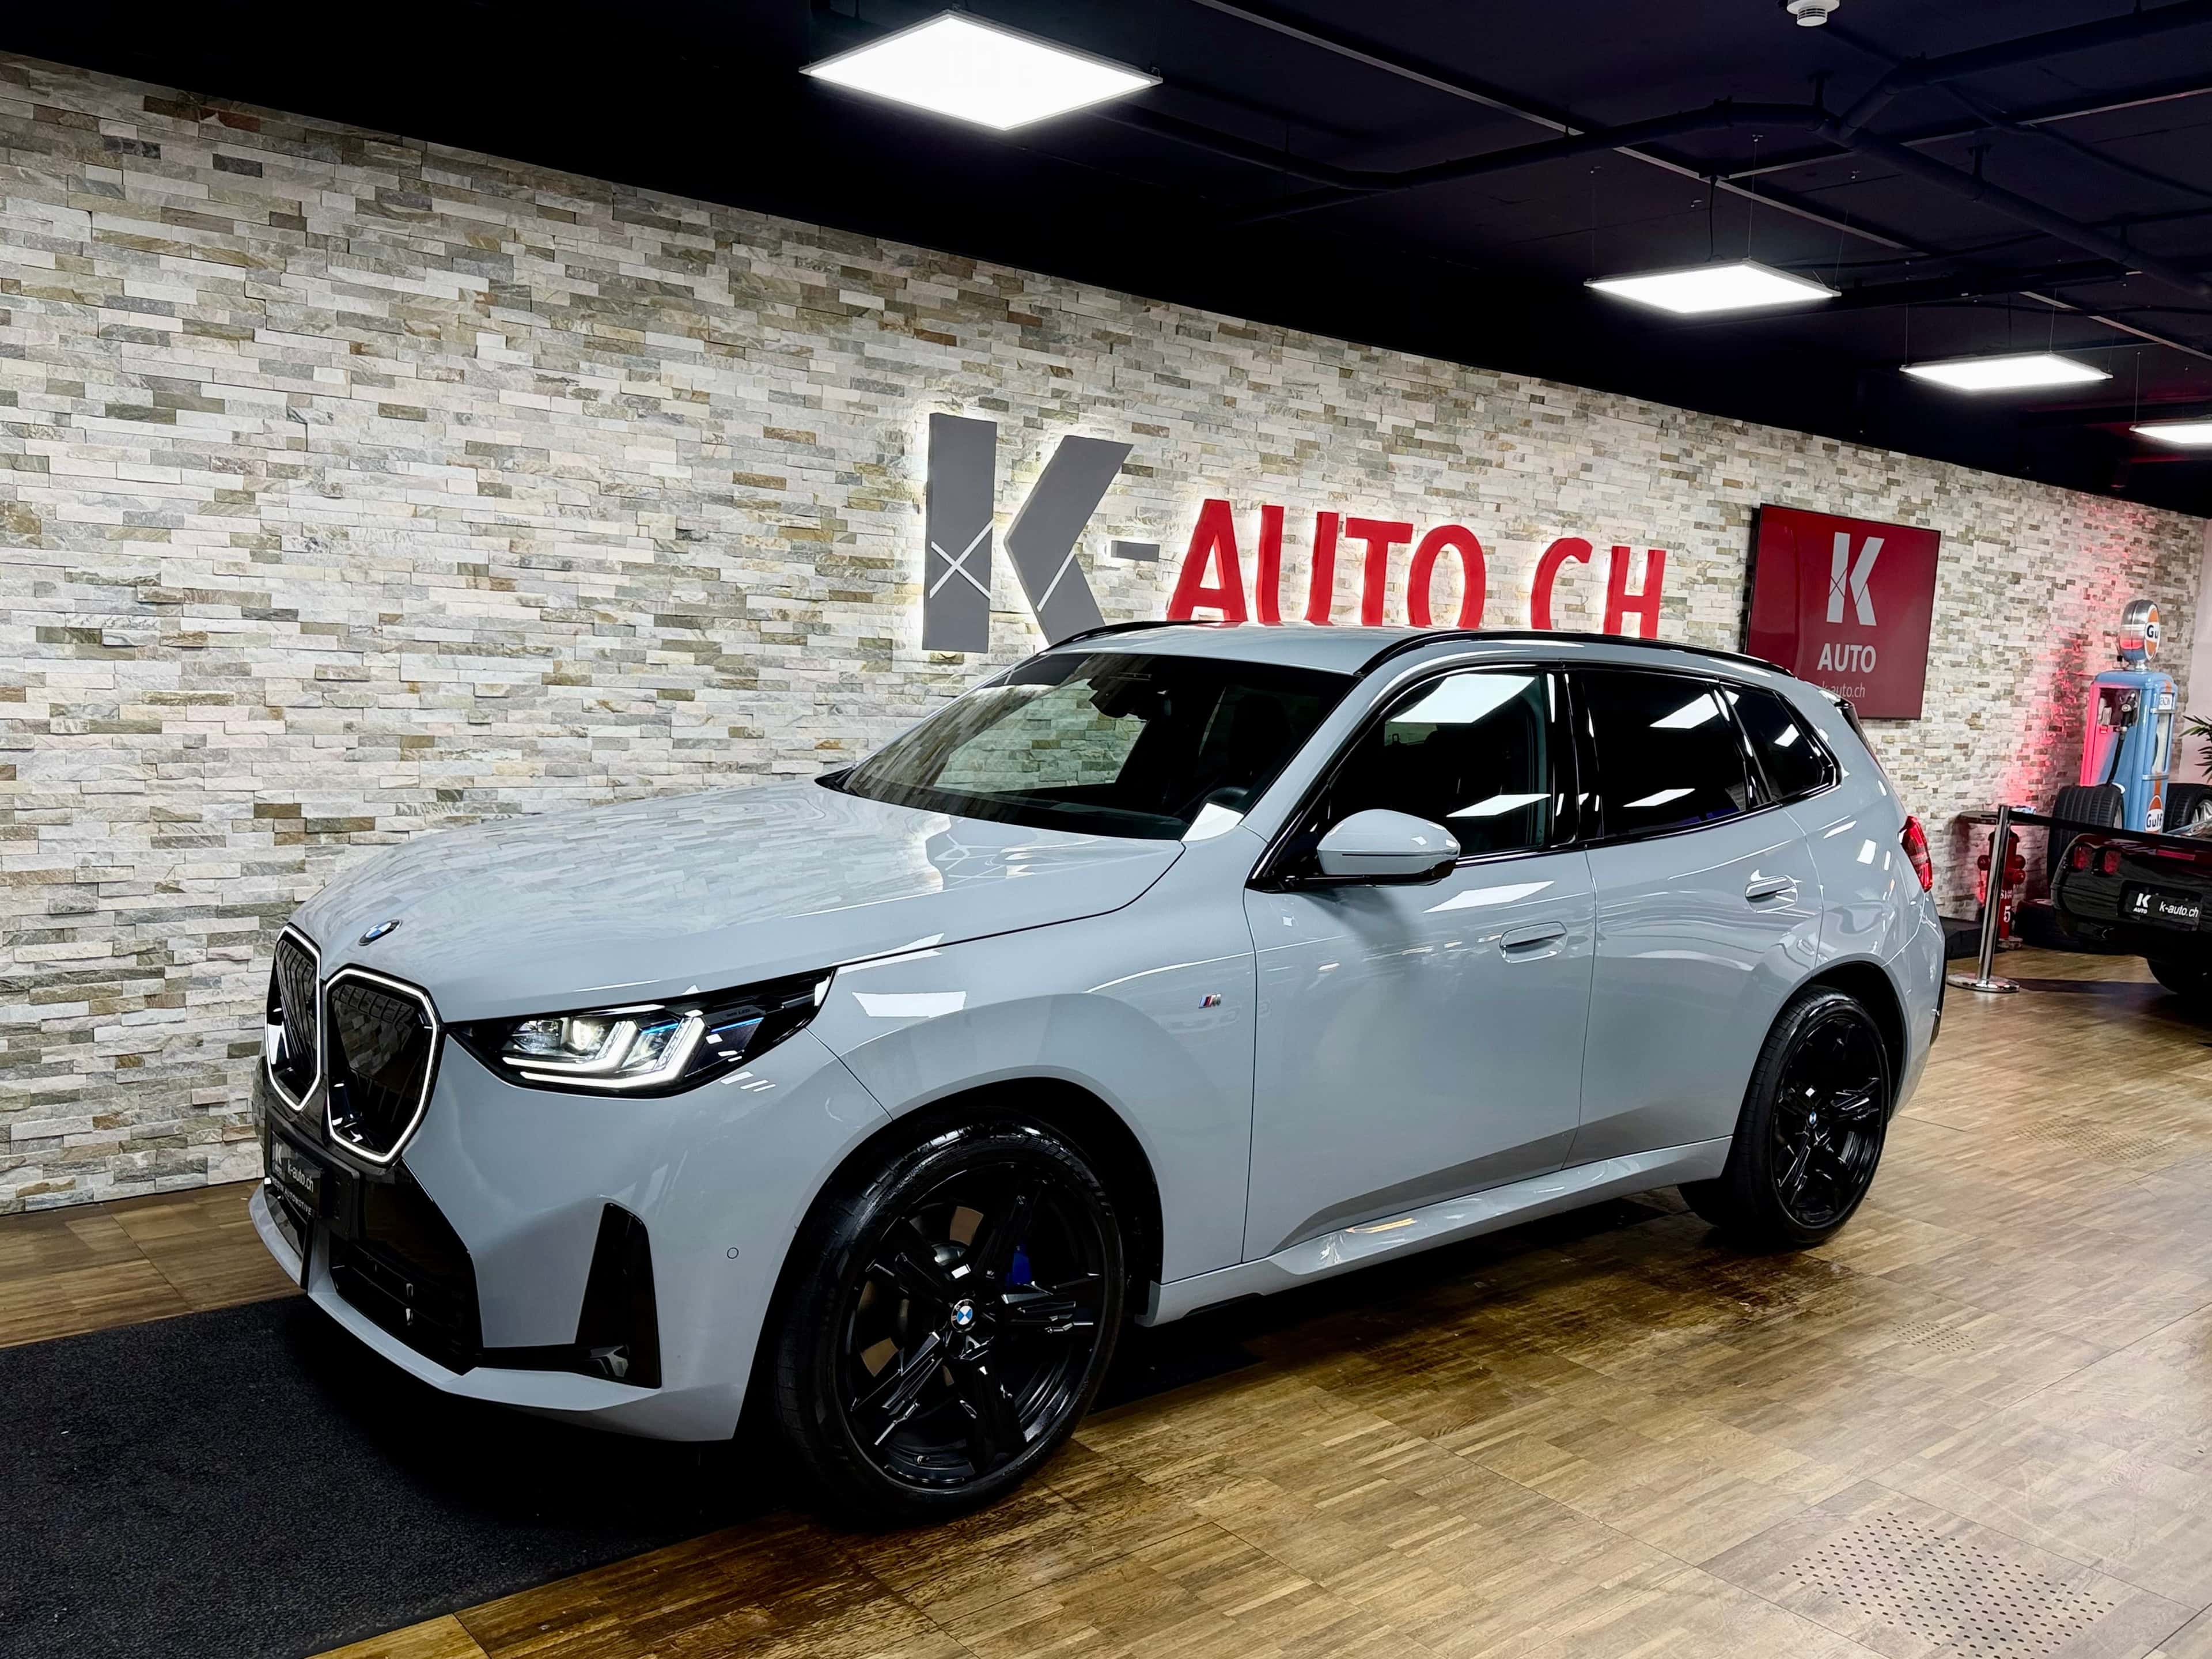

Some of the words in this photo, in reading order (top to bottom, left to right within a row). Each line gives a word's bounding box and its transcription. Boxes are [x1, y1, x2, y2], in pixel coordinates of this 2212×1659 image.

[1826, 531, 1885, 626] K
[1817, 642, 1876, 673] AUTO
[1821, 680, 1866, 698] kauto.ch
[2146, 813, 2162, 828] Gulf
[2135, 892, 2152, 908] K
[2158, 900, 2199, 918] k-auto.ch
[2003, 905, 2011, 923] 5
[287, 1158, 314, 1193] k-auto.ch
